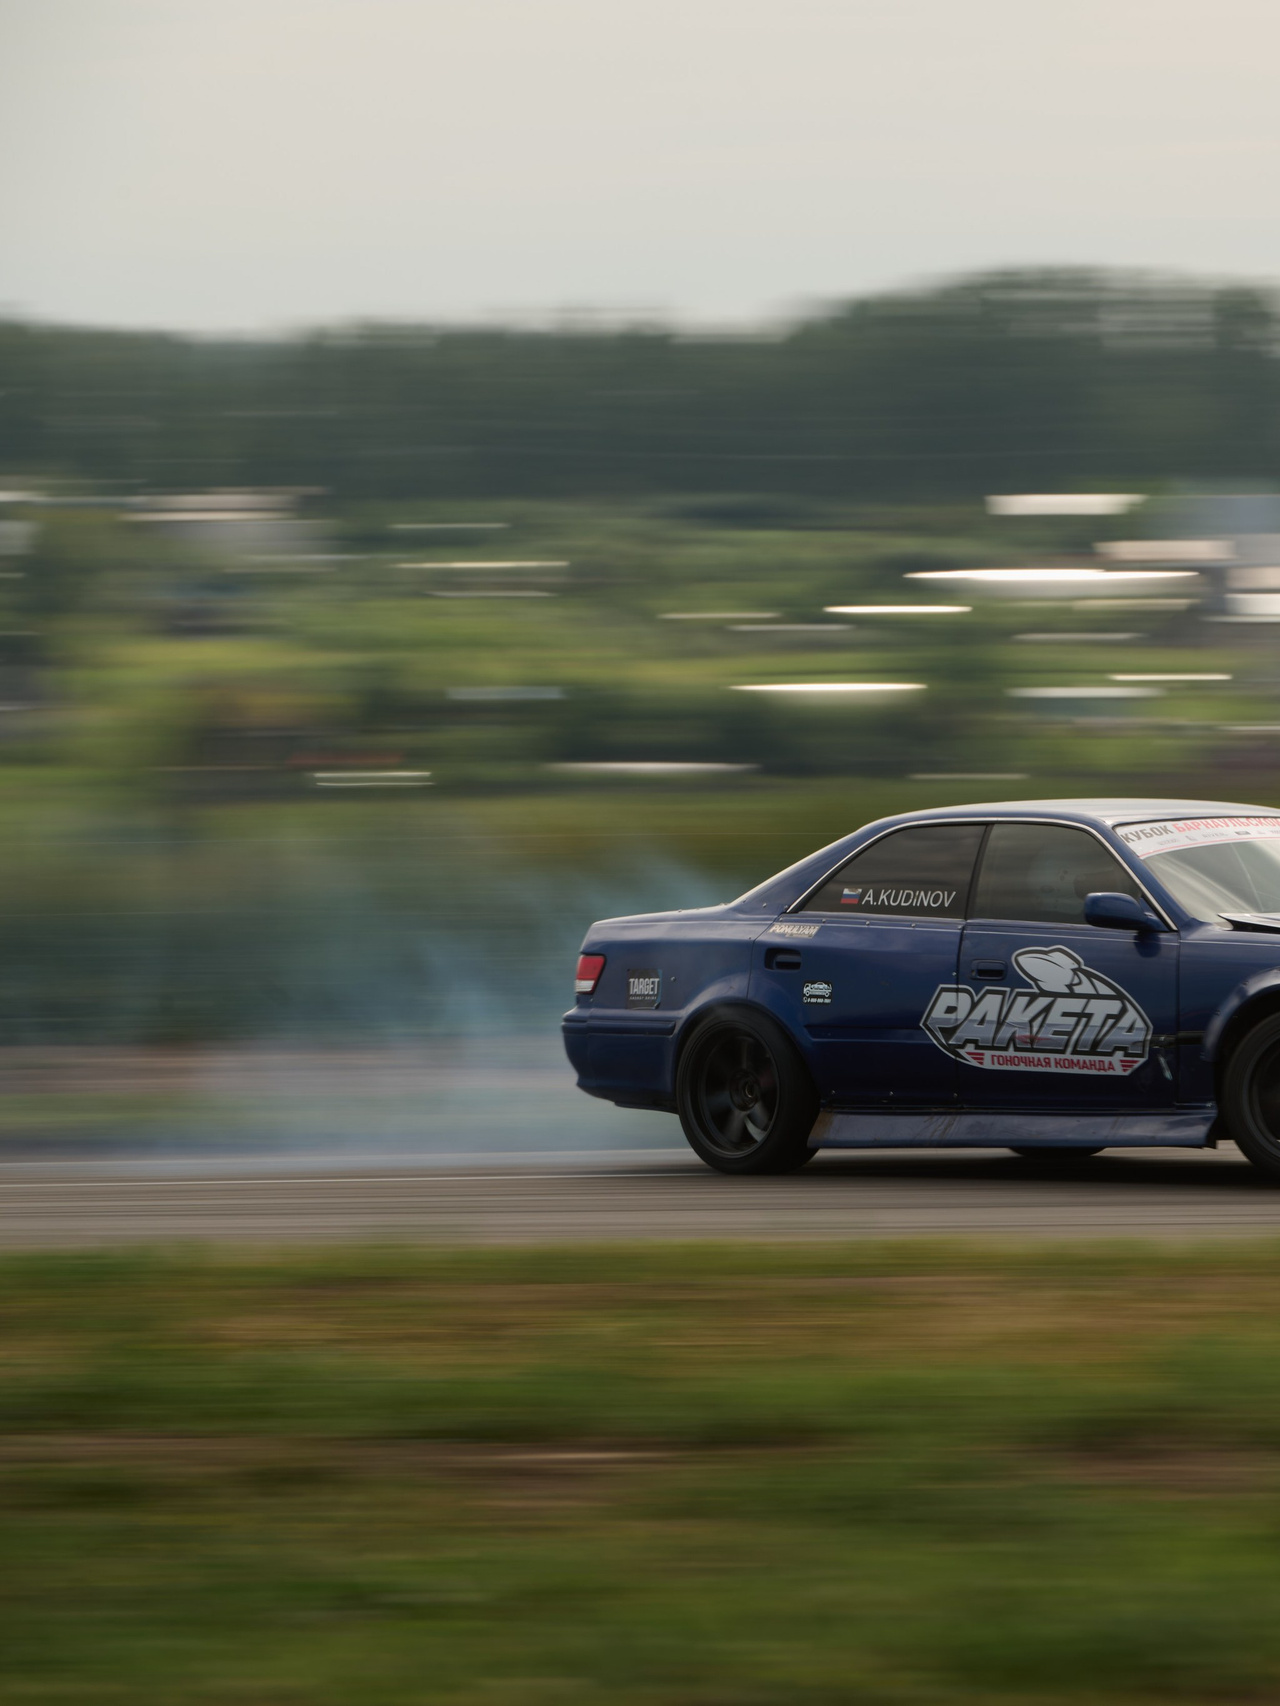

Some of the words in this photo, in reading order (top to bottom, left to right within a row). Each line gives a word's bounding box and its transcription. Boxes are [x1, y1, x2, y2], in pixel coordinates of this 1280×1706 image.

[1120, 825, 1174, 843] КУБОК
[862, 889, 956, 907] A.KUDINOV
[629, 978, 660, 995] TARGET
[924, 988, 1149, 1056] РАКЕТА
[991, 1054, 1050, 1068] ГОНОЧНАЯ
[1054, 1057, 1116, 1072] КОМАНДА
